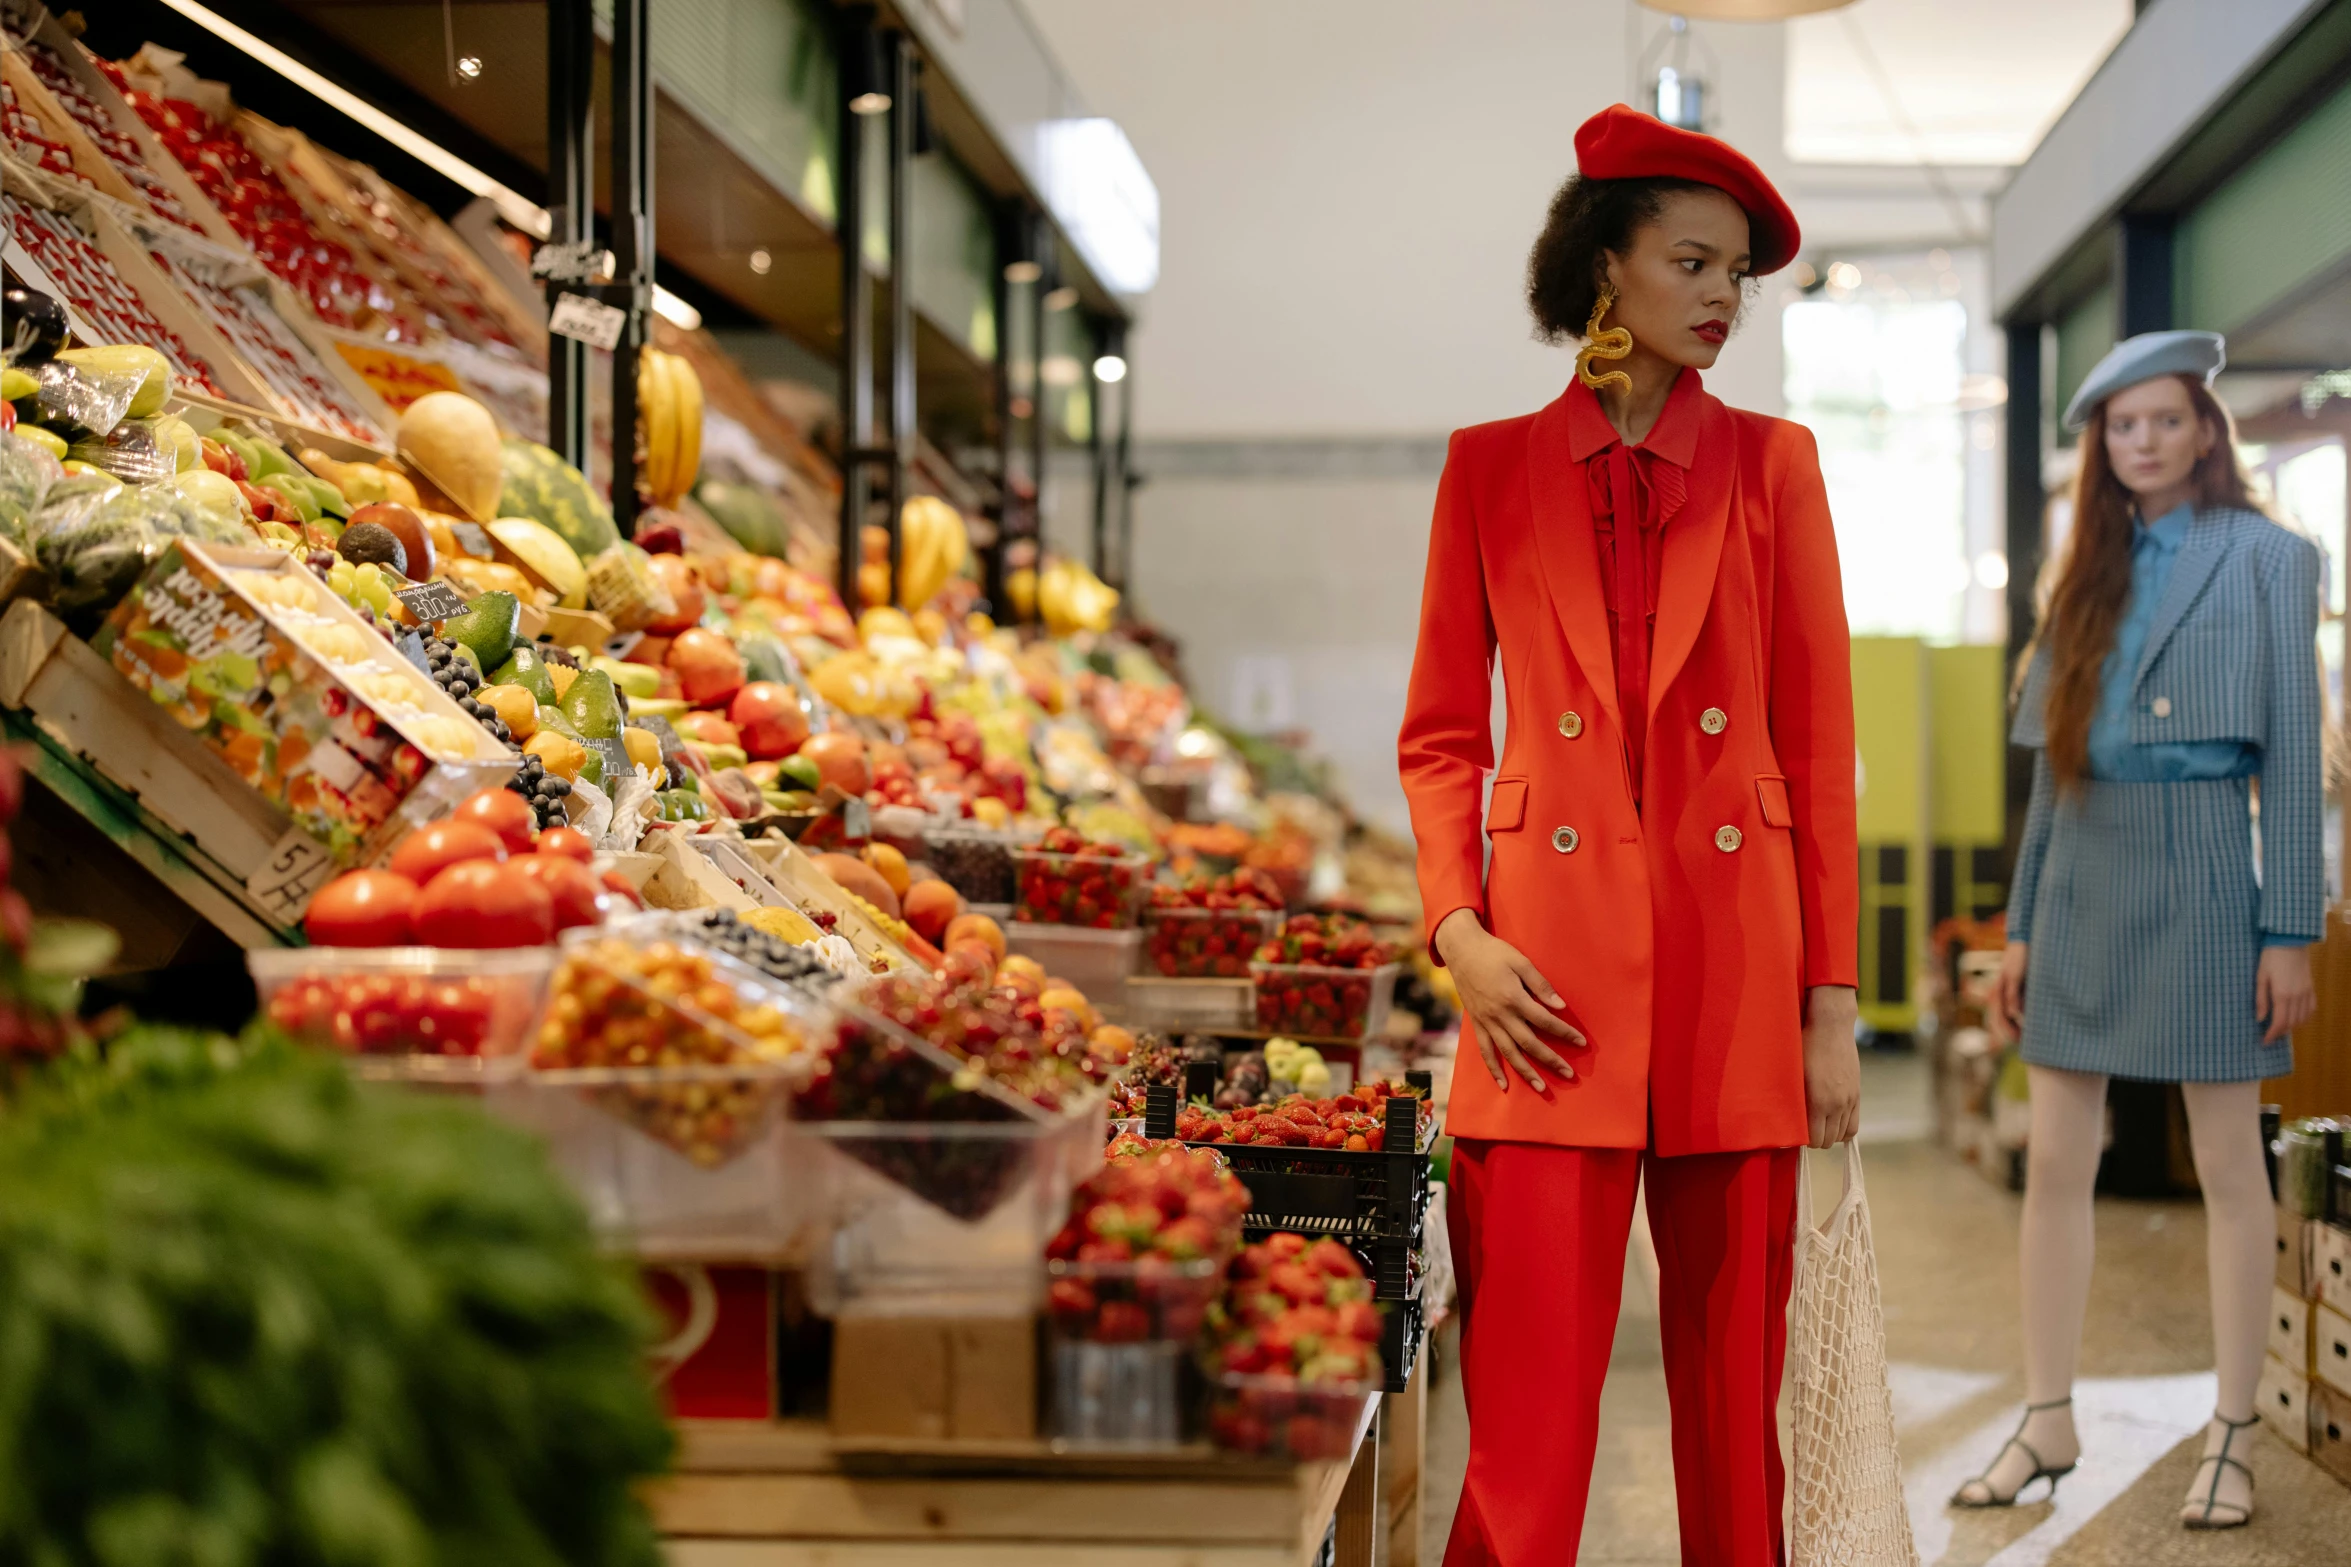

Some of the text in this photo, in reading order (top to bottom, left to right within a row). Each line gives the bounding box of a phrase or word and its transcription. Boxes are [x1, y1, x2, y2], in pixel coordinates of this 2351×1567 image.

[412, 598, 448, 620] 300
[143, 586, 226, 661] Apple
[605, 761, 621, 776] 00
